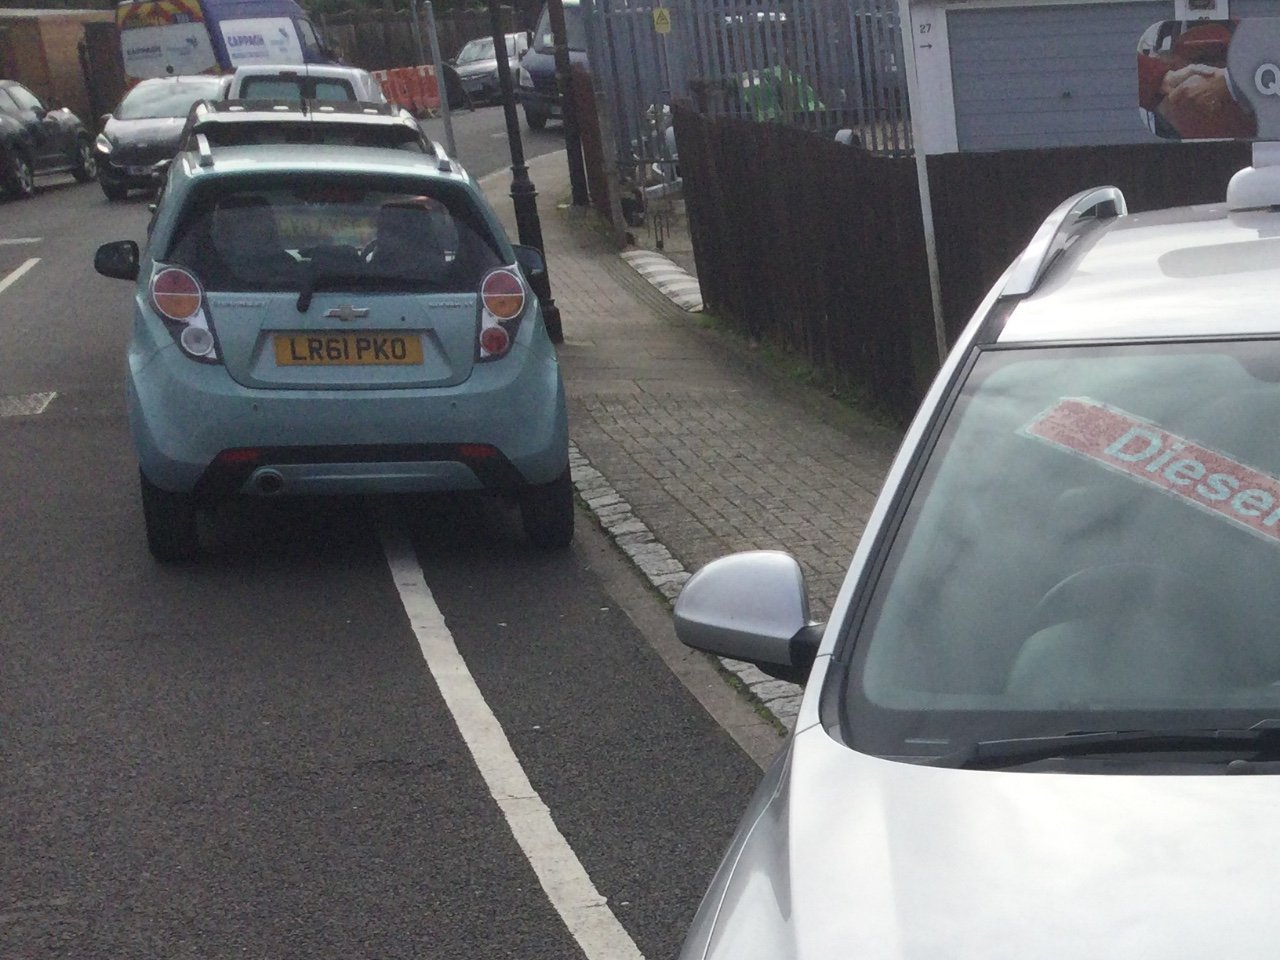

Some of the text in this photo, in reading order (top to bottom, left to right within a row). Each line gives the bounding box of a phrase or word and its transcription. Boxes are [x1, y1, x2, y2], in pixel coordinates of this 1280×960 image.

[918, 23, 932, 34] 27
[289, 337, 407, 361] LR61 PKO
